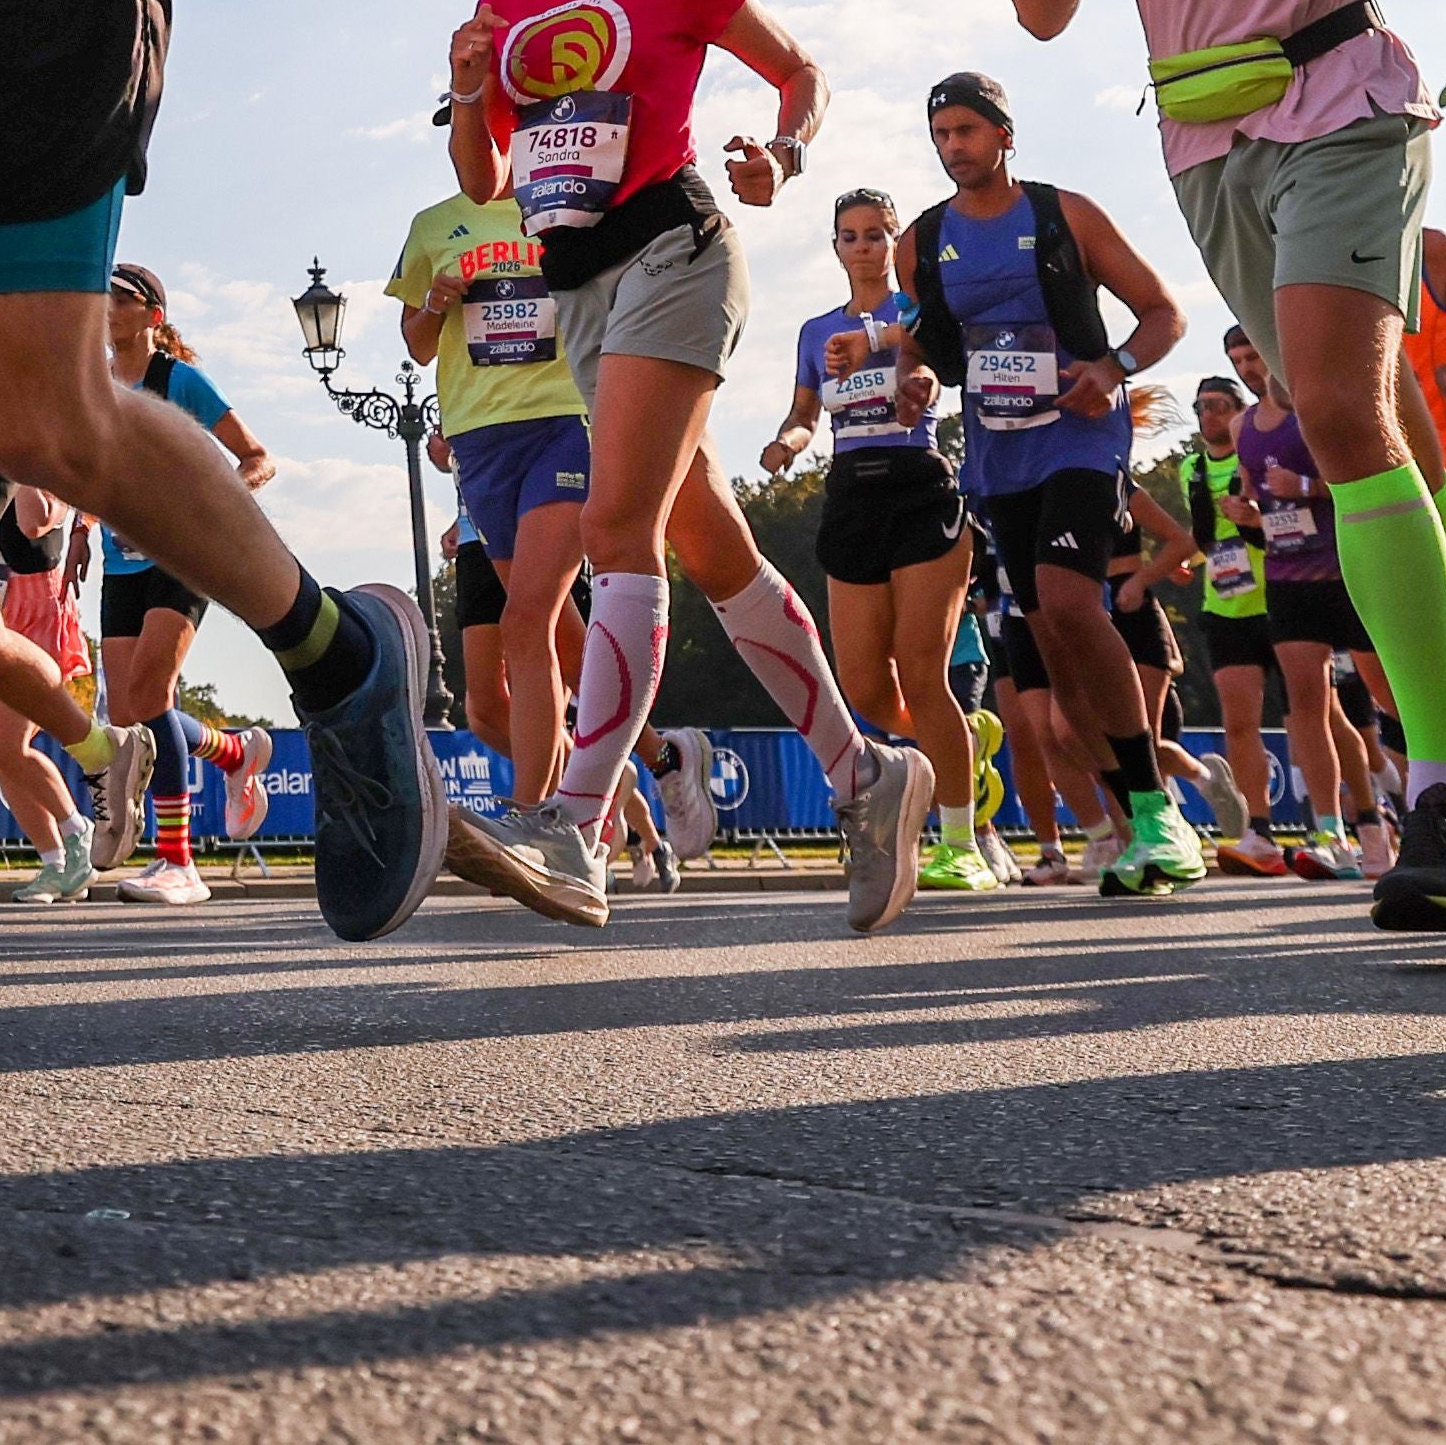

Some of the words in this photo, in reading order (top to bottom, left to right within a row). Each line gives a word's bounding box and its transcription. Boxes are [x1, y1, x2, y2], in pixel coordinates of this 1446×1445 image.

[529, 126, 597, 153] 74818
[537, 148, 580, 164] Sandra
[531, 179, 587, 200] zalando
[491, 260, 521, 273] 2026
[482, 302, 538, 321] 25982
[487, 320, 535, 331] Madeleine
[489, 341, 535, 355] zalando
[980, 356, 1036, 372] 29452
[836, 372, 885, 394] 22858
[983, 396, 1034, 407] zalando
